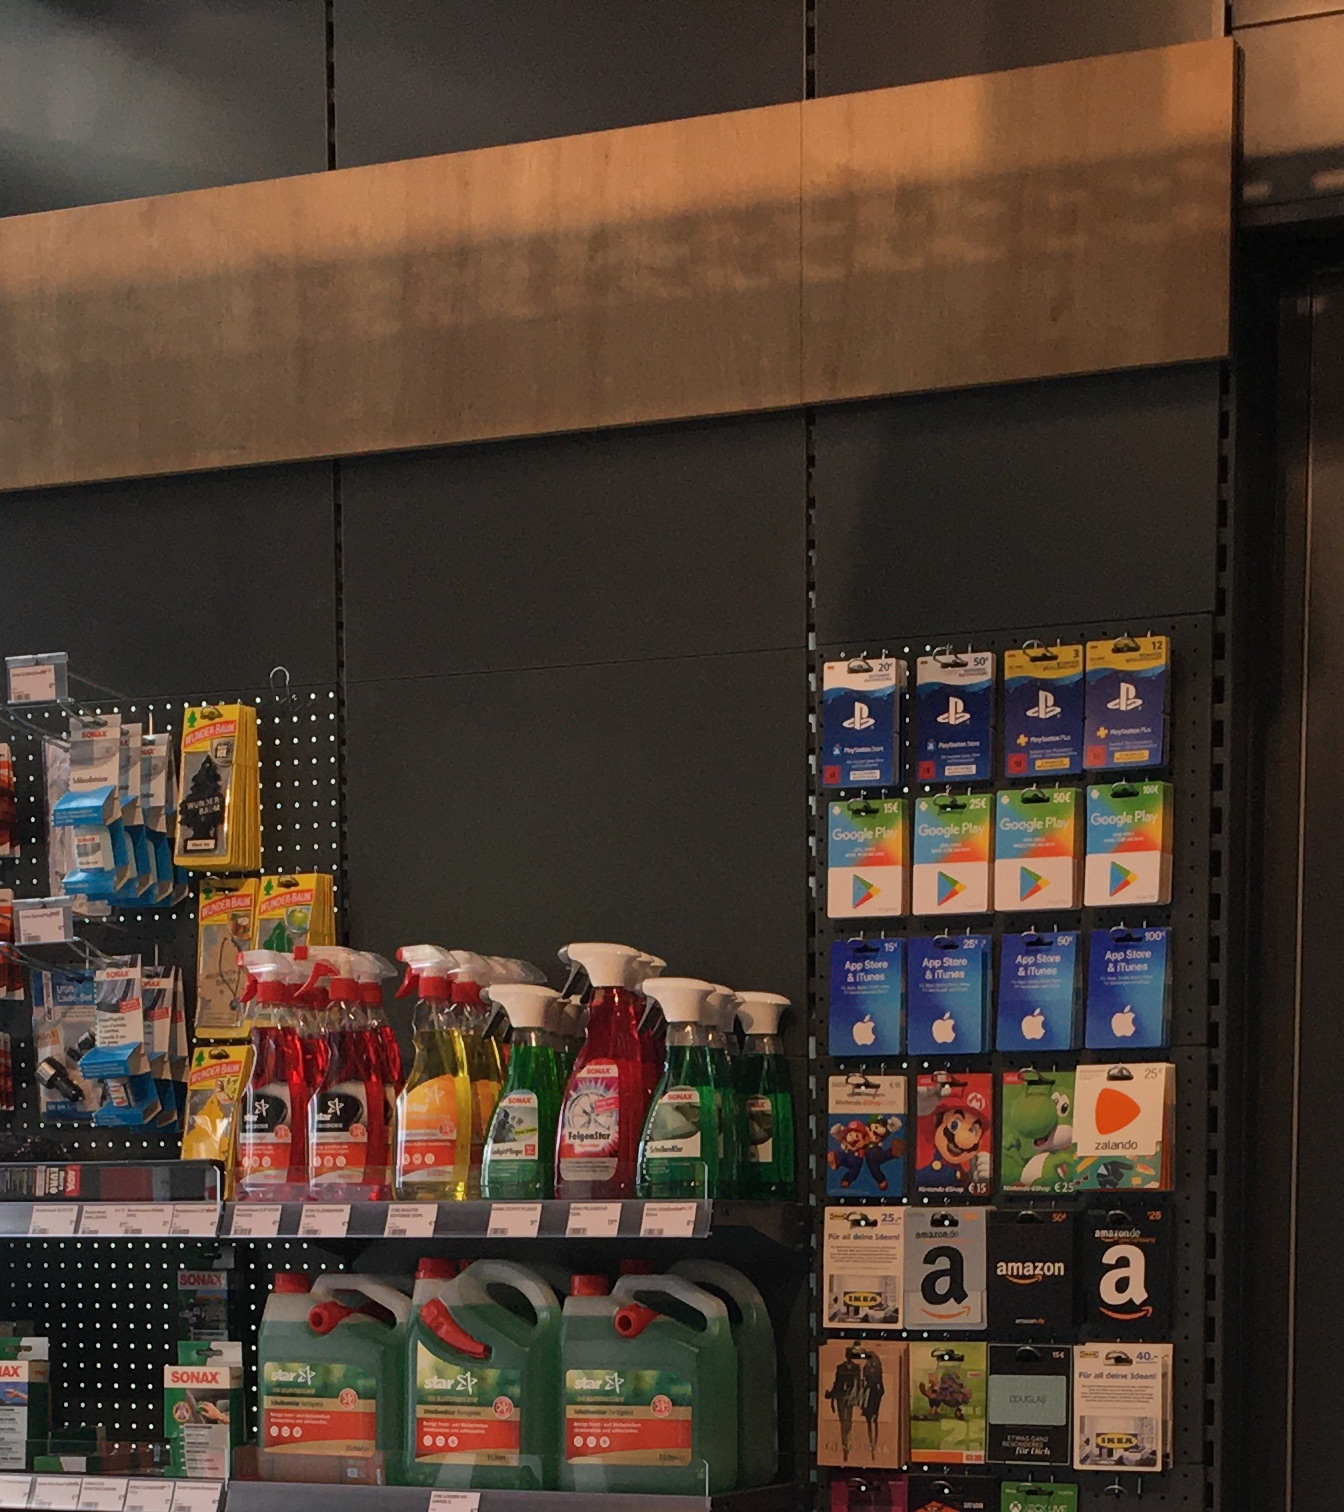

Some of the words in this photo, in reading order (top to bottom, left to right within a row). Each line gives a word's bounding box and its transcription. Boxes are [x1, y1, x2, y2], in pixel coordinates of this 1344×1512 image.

[1152, 641, 1162, 650] 12
[82, 730, 108, 738] SONAX
[1053, 793, 1071, 803] 50€
[884, 803, 898, 813] 15€
[970, 799, 986, 810] 25€
[1091, 812, 1132, 827] Google
[1135, 810, 1157, 824] Play
[1000, 818, 1043, 832] Google
[1046, 817, 1069, 831] Play
[832, 828, 874, 842] Google
[875, 827, 898, 839] Play
[918, 824, 959, 838] Google
[962, 823, 985, 838] Play
[1015, 955, 1034, 965] App
[1037, 954, 1061, 963] Store
[1105, 951, 1124, 961] App
[1127, 950, 1151, 959] Store
[845, 961, 862, 971] App
[865, 960, 888, 969] Store
[922, 958, 941, 968] App
[943, 957, 967, 966] Store
[1107, 964, 1114, 972] &
[1117, 963, 1148, 972] iTunes
[847, 973, 854, 982] &
[856, 972, 885, 981] iTunes
[925, 970, 932, 979] &
[935, 970, 964, 979] iTunes
[1018, 967, 1025, 976] &
[1028, 967, 1057, 975] iTunes
[1095, 1140, 1138, 1150] zalando
[977, 1184, 986, 1193] 15
[1063, 1183, 1074, 1192] 25
[997, 1262, 1064, 1275] amazon
[179, 1274, 223, 1285] SONAX
[921, 1246, 968, 1305] a
[1100, 1245, 1148, 1305] a
[170, 1371, 219, 1384] SONAX
[271, 1370, 295, 1381] star
[424, 1378, 454, 1389] star
[575, 1378, 603, 1390] star
[1023, 1504, 1047, 1512] XBOX
